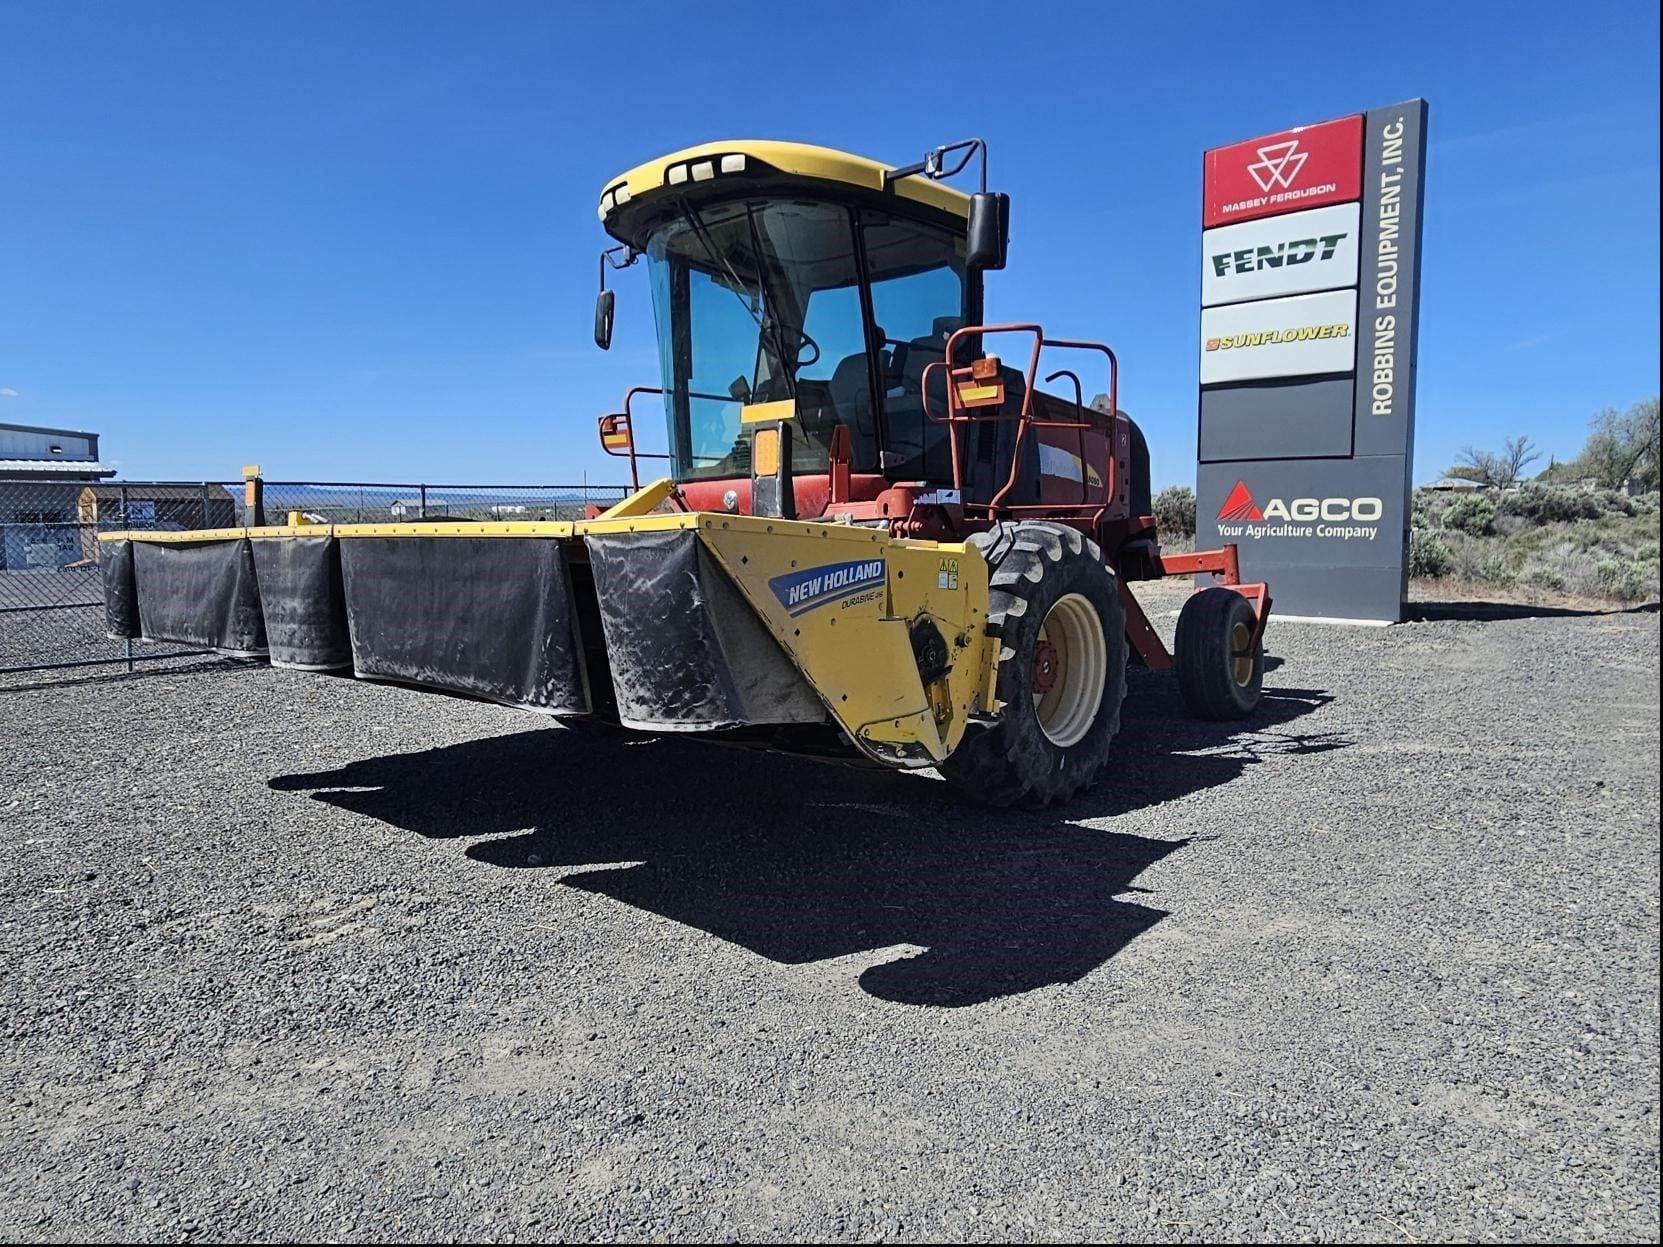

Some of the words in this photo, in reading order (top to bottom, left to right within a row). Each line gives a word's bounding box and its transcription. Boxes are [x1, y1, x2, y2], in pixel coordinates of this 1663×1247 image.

[1382, 116, 1404, 166] INC.
[1222, 197, 1267, 213] MASSEY
[1270, 183, 1336, 204] FERGUSON
[1212, 232, 1348, 277] FENDT
[1376, 167, 1404, 309] EQUIPMENT,
[1219, 323, 1349, 350] SUNFLOWER
[1371, 315, 1396, 415] ROBBINS
[1217, 524, 1245, 537] Your
[1245, 523, 1313, 540] Agriculture
[1316, 524, 1378, 540] Company
[1262, 497, 1383, 522] AGCO
[788, 576, 822, 606] NEW
[823, 561, 882, 592] HOLLAND
